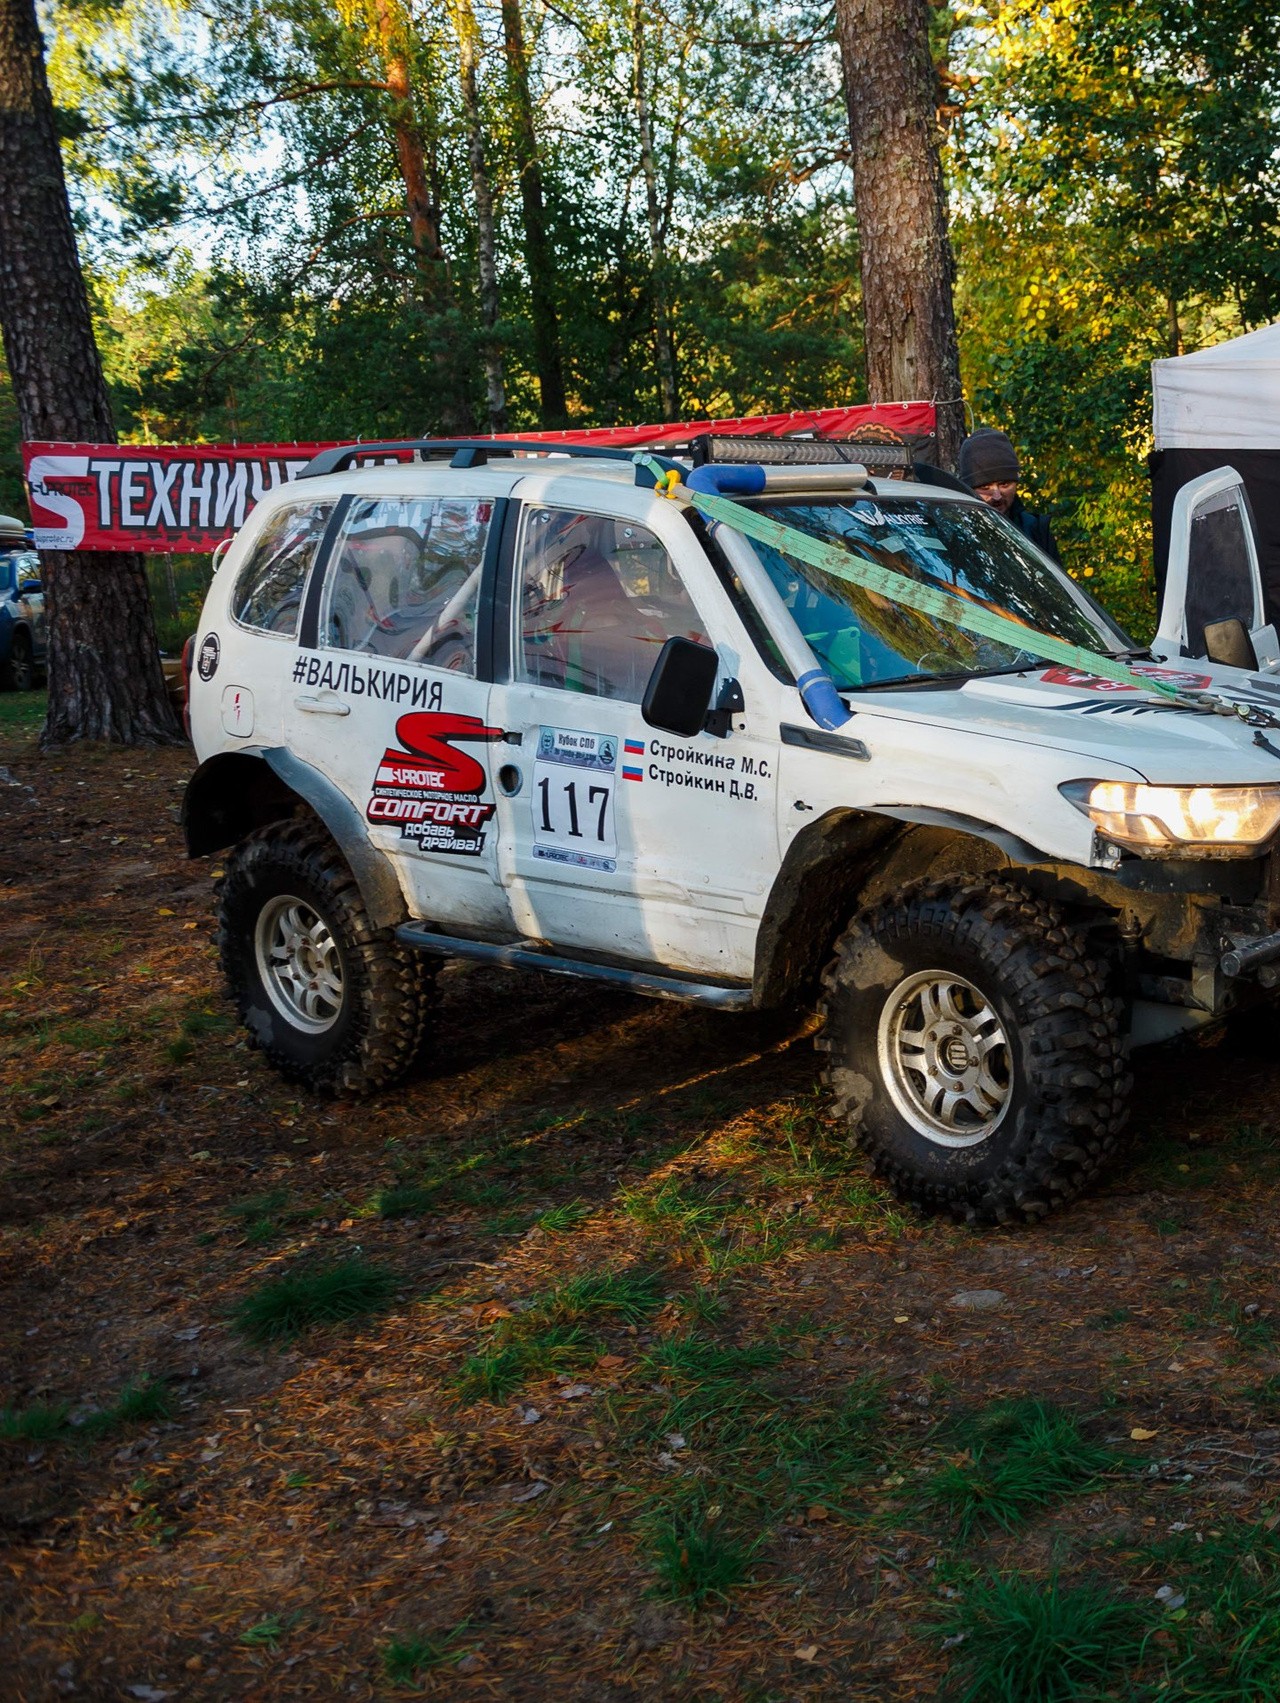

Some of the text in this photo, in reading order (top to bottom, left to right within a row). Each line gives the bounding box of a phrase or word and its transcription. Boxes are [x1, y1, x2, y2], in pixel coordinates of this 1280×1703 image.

[30, 481, 94, 496] SUPROTEC
[293, 655, 443, 711] #ВАЛЬКИРИЯ
[558, 733, 595, 749] Кубок СПб
[650, 740, 772, 778] Стройкина М.С.
[649, 764, 758, 801] Стройкин Д.В.
[375, 787, 478, 803] СИНТЕТИЧЕСКОЕ МОТОРНОЕ МАСЛО
[368, 798, 488, 823] COMFORT
[538, 777, 609, 841] 117
[405, 821, 455, 837] добавь
[421, 836, 482, 851] драйва!
